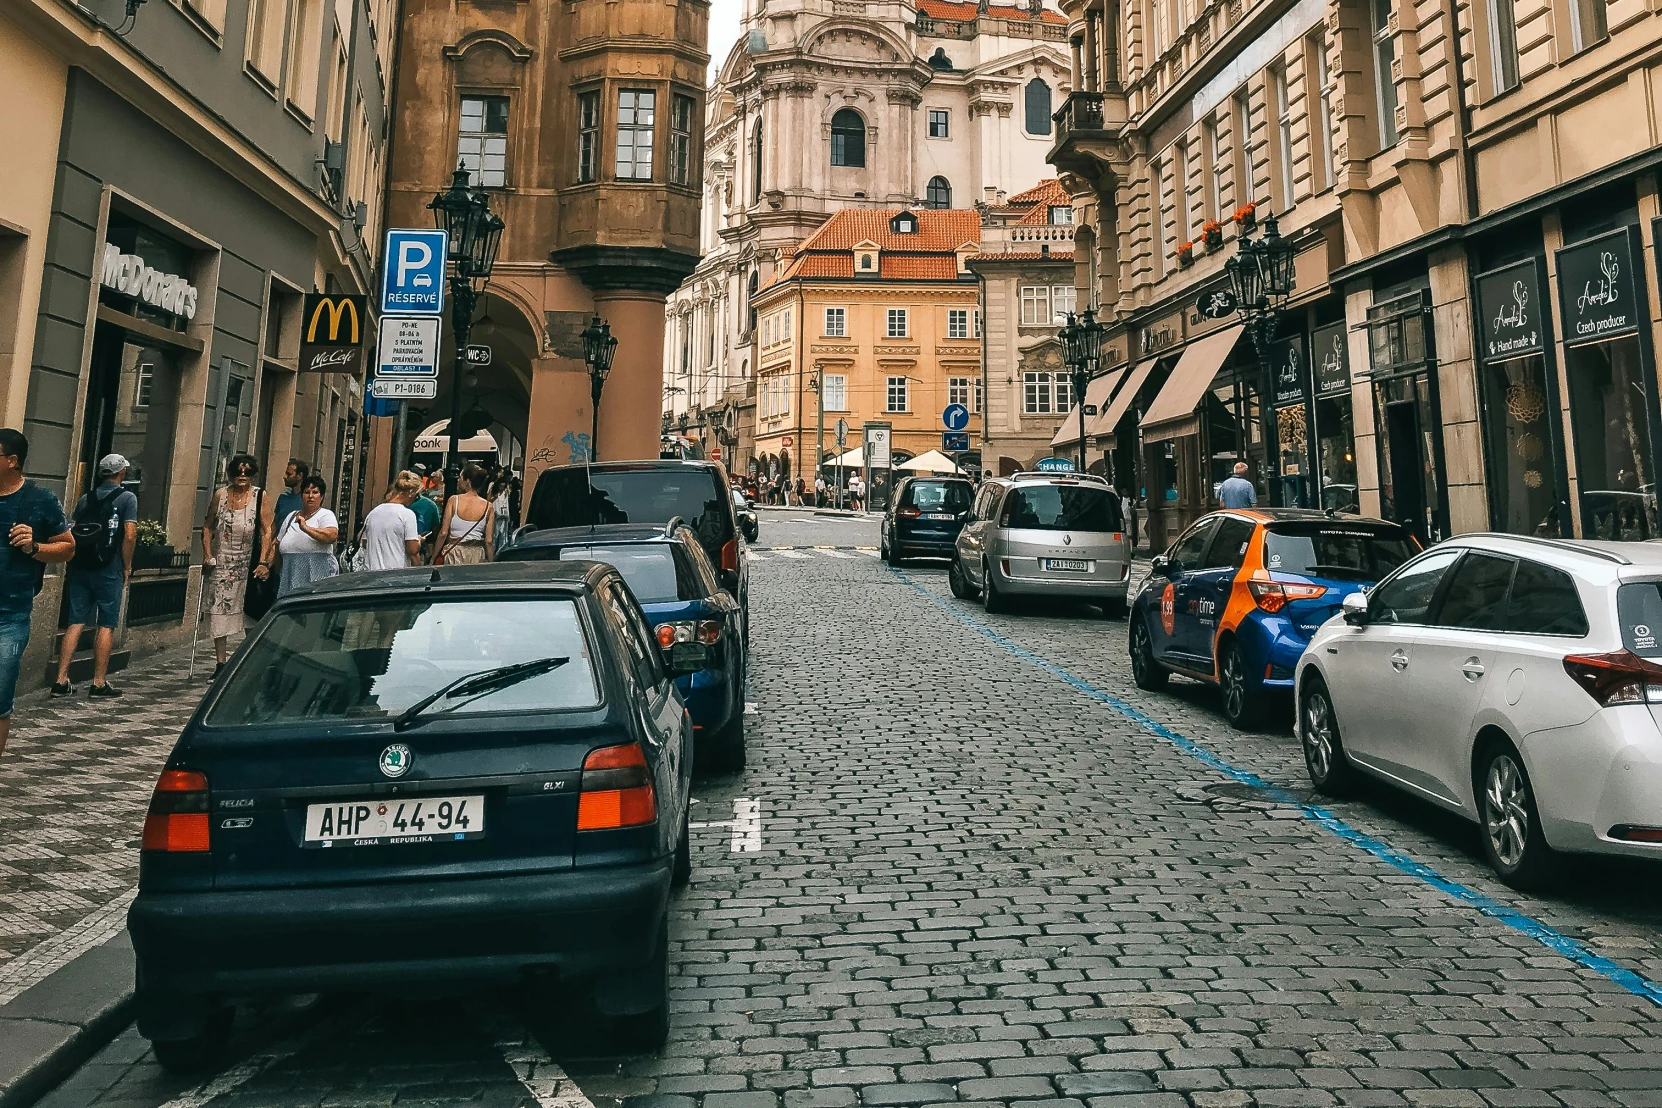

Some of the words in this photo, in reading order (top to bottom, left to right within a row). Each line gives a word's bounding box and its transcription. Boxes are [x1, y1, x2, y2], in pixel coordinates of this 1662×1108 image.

[388, 291, 437, 304] RÉSERVÉ
[1577, 319, 1596, 334] Czech
[1597, 314, 1626, 333] producer
[1497, 338, 1512, 352] Hand
[1513, 335, 1529, 348] made
[310, 348, 356, 370] McCafé
[467, 350, 480, 361] WC
[394, 383, 426, 394] P1-0186
[1330, 378, 1346, 391] producer
[1068, 561, 1085, 569] 0203
[219, 799, 254, 808] FELICIA
[319, 805, 371, 837] AHP
[392, 800, 470, 833] 44-94
[354, 838, 379, 846] ČESKÁ
[390, 836, 433, 844] REPUBLIKA
